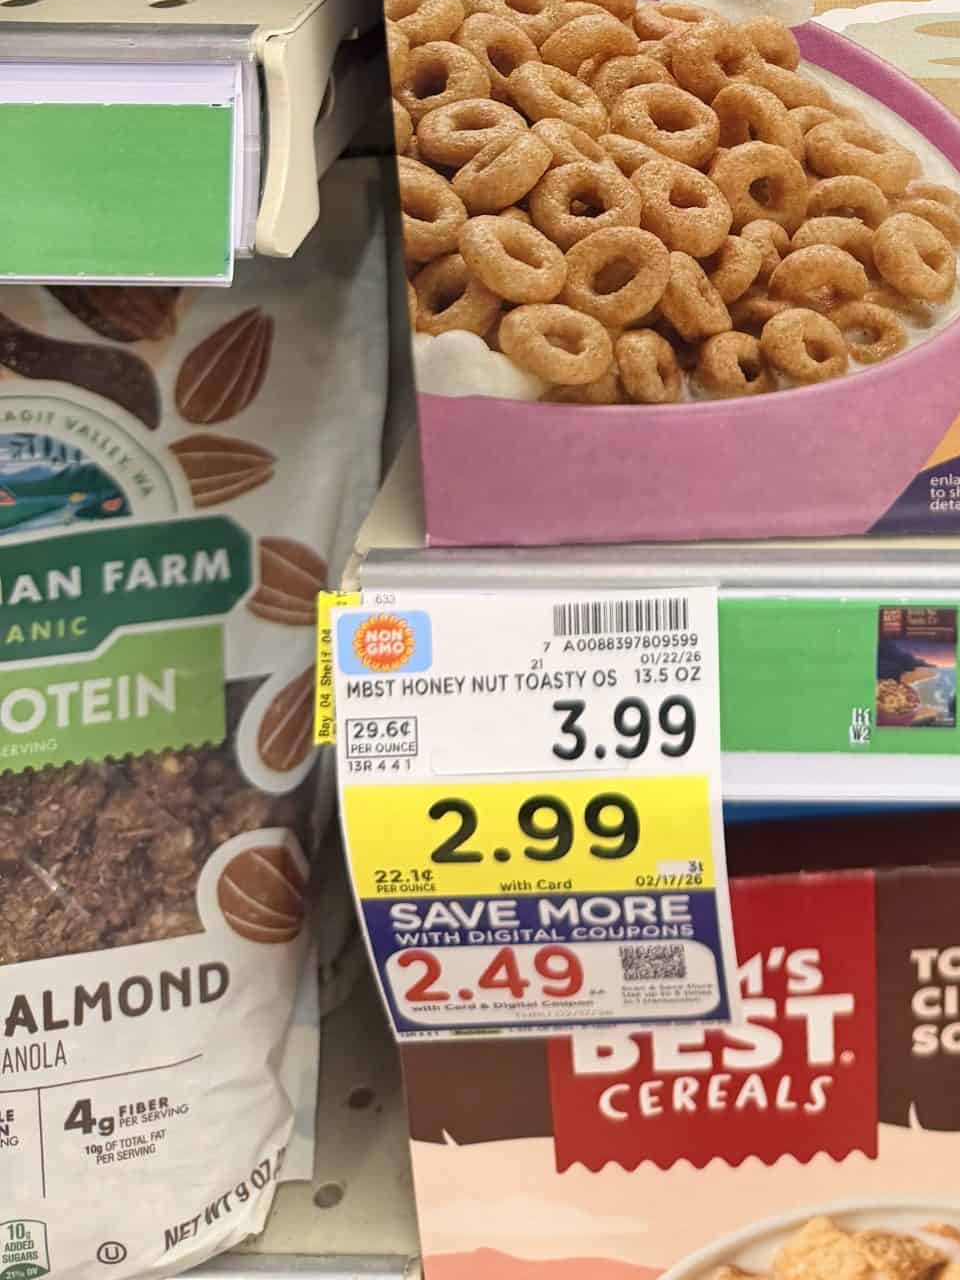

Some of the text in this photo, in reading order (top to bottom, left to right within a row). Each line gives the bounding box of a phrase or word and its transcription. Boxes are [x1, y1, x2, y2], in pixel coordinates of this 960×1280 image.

[930, 486, 946, 498] to
[103, 548, 231, 594] FARM
[365, 629, 404, 642] NON
[543, 633, 699, 653] 7 A0088397809599
[366, 641, 405, 655] GMO
[640, 651, 702, 665] 01/22/26
[320, 651, 333, 687] Shelf
[530, 658, 544, 671] 21
[347, 665, 702, 699] MBST HONEY NUT TOASTY OS 13.5 OZ
[318, 717, 331, 737] Bay
[353, 720, 411, 739] 29.6¢
[552, 694, 697, 761] 3.99
[351, 741, 416, 754] PER OUNCE
[428, 792, 641, 864] 2.99
[374, 868, 433, 884] 22.1¢
[499, 879, 573, 892] with Card
[635, 873, 703, 888] 02/17/26
[376, 882, 437, 894] PER OUNCE
[389, 894, 692, 931] SAVE MORE
[396, 923, 695, 946] WITH DIGITAL COUPONS
[396, 944, 584, 1002] 2.49
[4, 961, 230, 1039] ALMOND
[118, 1096, 169, 1117] FIBER
[598, 1073, 833, 1120] CEREALS
[119, 1103, 190, 1129] PER SERVING
[85, 1129, 167, 1156] 10g OF TOTAL FAT
[96, 1143, 157, 1165] PER SERVING
[163, 1213, 202, 1252] NET
[204, 1190, 232, 1225] WT
[4, 1239, 35, 1253] ADDED
[2, 1249, 39, 1264] SUGARS
